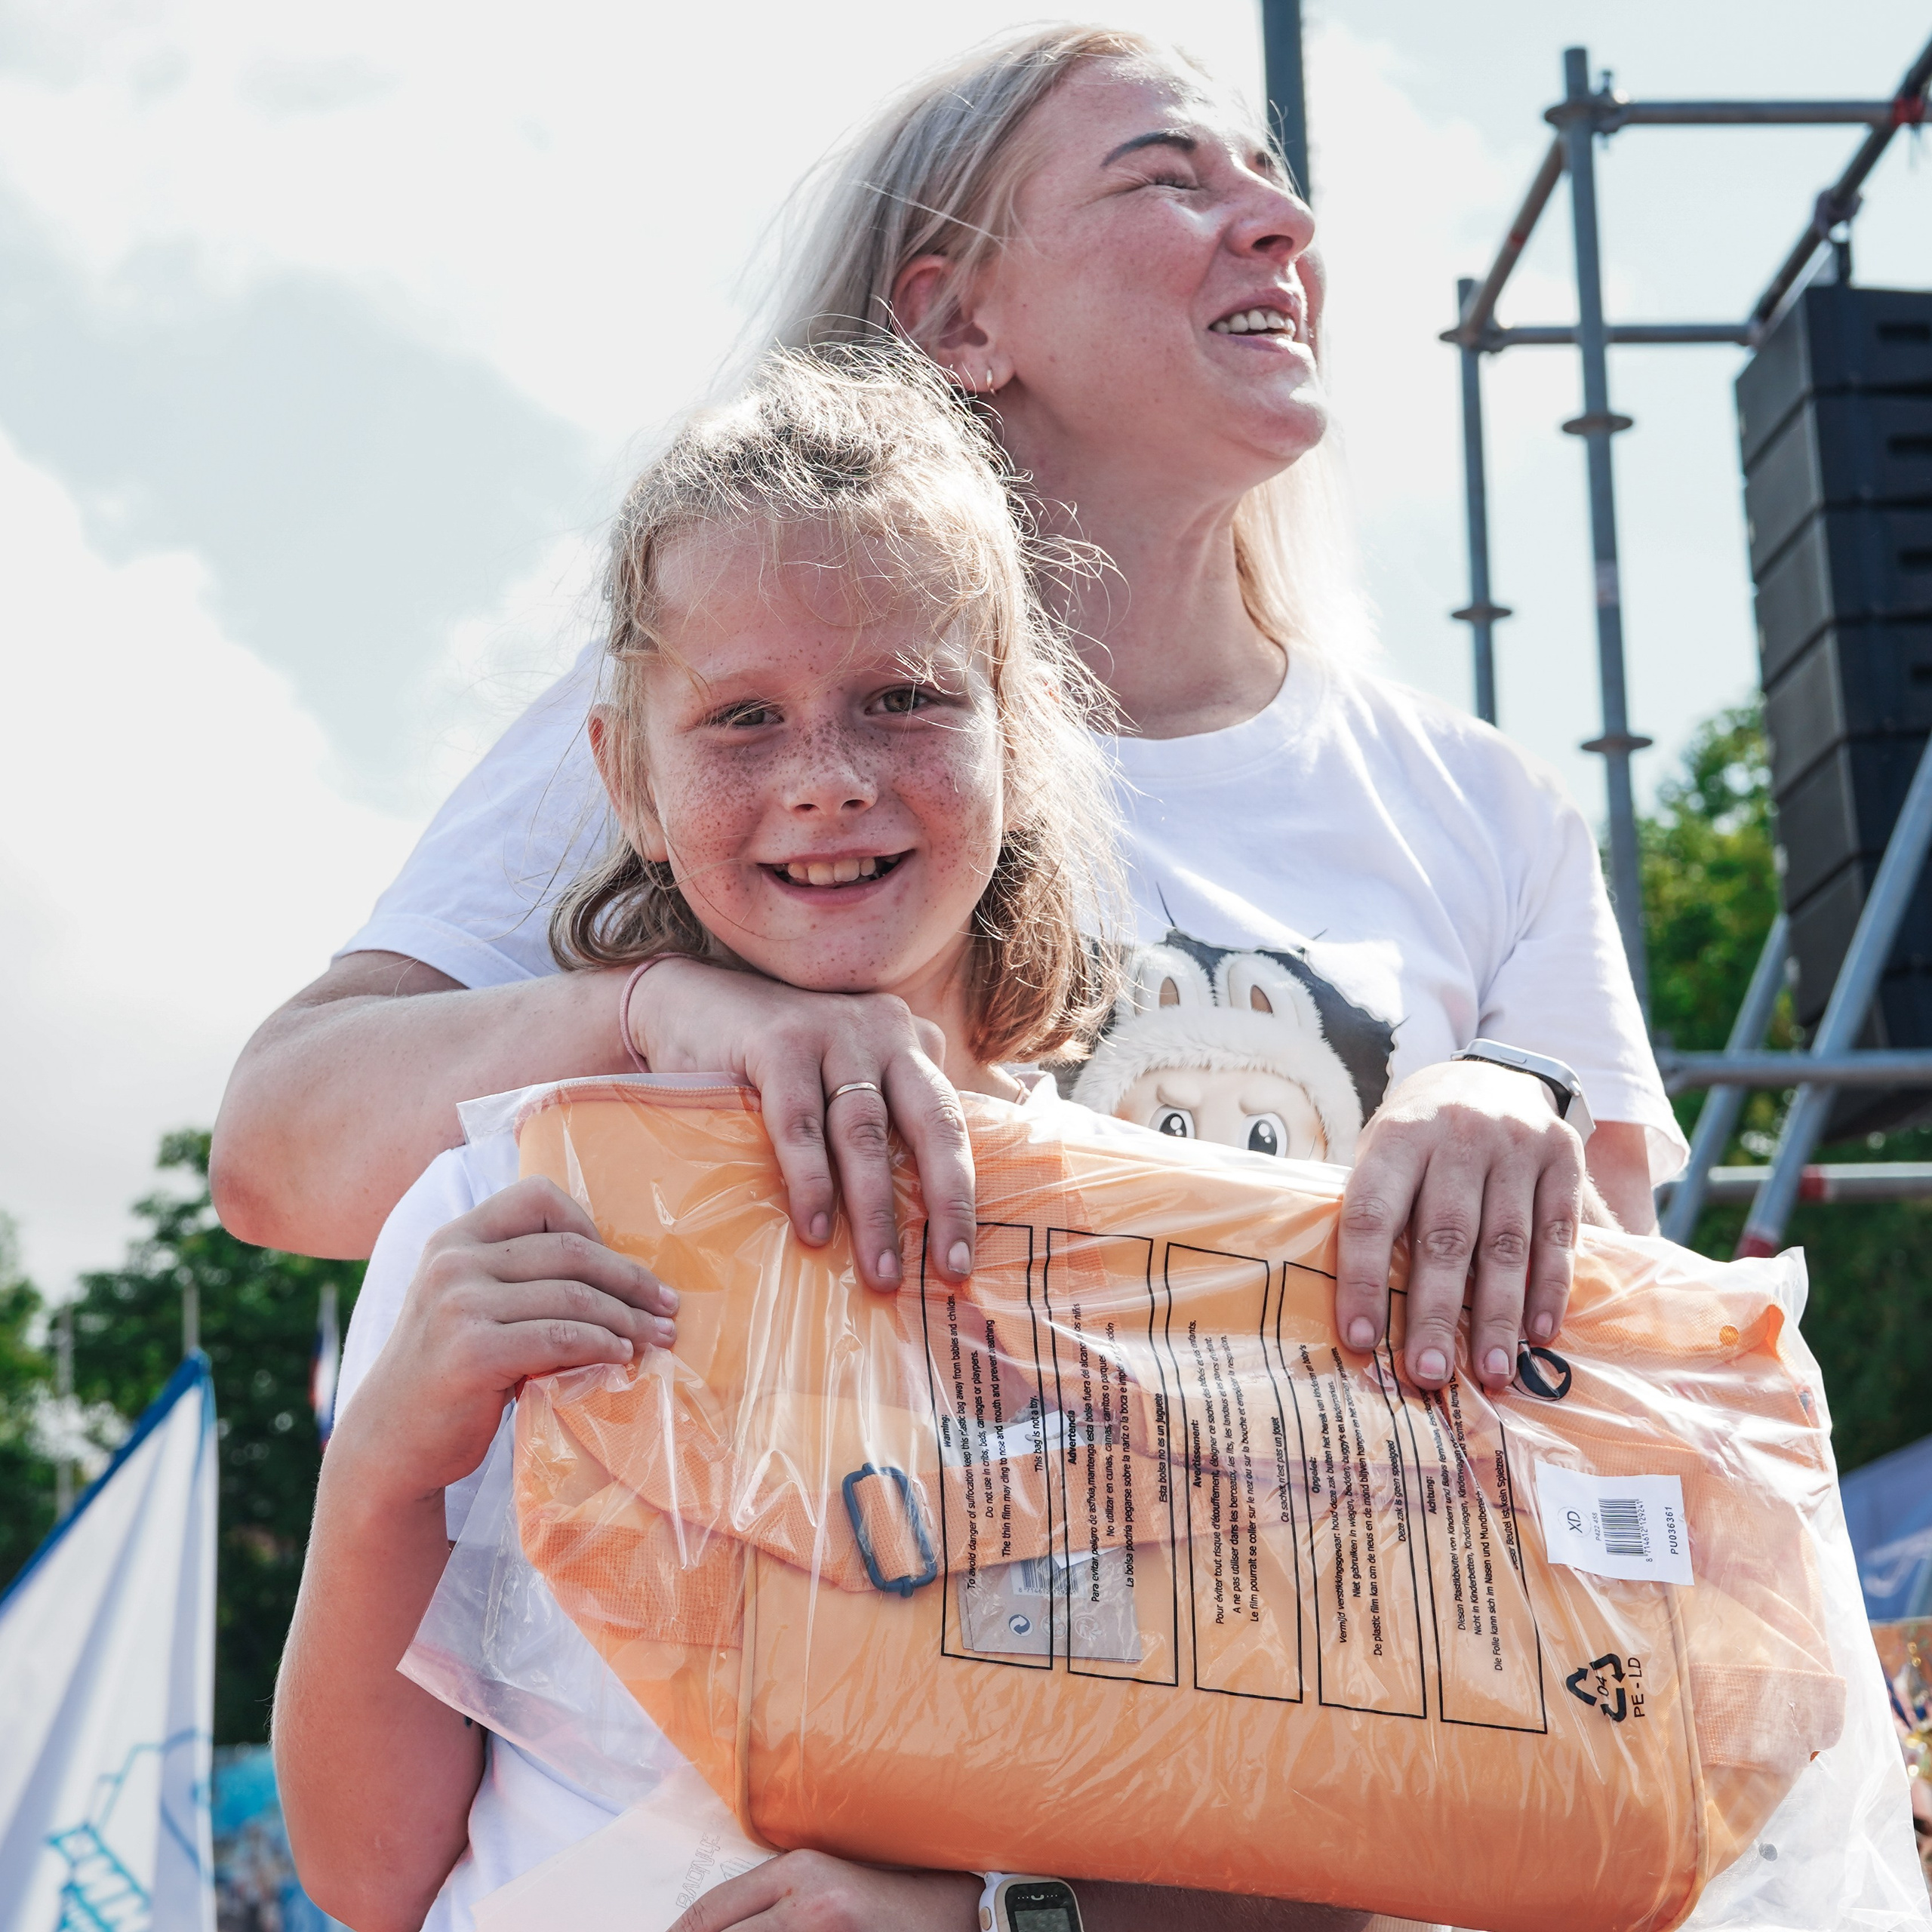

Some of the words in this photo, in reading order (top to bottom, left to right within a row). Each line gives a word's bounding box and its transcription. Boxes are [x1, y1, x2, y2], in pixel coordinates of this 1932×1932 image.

[948, 1323, 958, 1337] and
[950, 1337, 961, 1361] babies
[952, 1362, 961, 1380] from
[971, 1349, 983, 1384] playpens.
[988, 1355, 1001, 1382] prevent
[1080, 1368, 1090, 1379] del
[1098, 1354, 1110, 1383] parques
[1213, 1362, 1223, 1382] parcs
[955, 1380, 964, 1400] away
[989, 1383, 1000, 1398] and
[1082, 1380, 1091, 1401] fuera
[1449, 1383, 1460, 1408] Atmung
[955, 1400, 966, 1414] bag
[974, 1395, 985, 1429] carriages
[991, 1398, 1002, 1423] mouth
[1029, 1395, 1039, 1408] toy.
[1100, 1392, 1111, 1422] carritos
[1119, 1394, 1128, 1414] boca
[1154, 1393, 1165, 1425] juguete
[1204, 1399, 1215, 1423] sachet
[1221, 1398, 1231, 1426] landaus
[1316, 1399, 1325, 1411] van
[1030, 1416, 1040, 1429] not
[1083, 1403, 1094, 1423] bolsa
[1318, 1412, 1329, 1435] bereik
[1453, 1408, 1462, 1420] die
[940, 1414, 952, 1447] Warning:
[994, 1425, 1004, 1439] and
[1085, 1424, 1094, 1441] esta
[1224, 1427, 1232, 1439] les
[1238, 1417, 1249, 1444] bouche
[1270, 1416, 1282, 1436] jouet
[1454, 1420, 1465, 1441] somit
[960, 1437, 970, 1450] this
[977, 1430, 987, 1447] beds,
[1033, 1438, 1043, 1454] bag
[1066, 1410, 1077, 1465] Advertencia
[1104, 1423, 1112, 1452] camas,
[1121, 1432, 1130, 1453] nariz
[1226, 1441, 1235, 1454] lits,
[1321, 1435, 1331, 1448] het
[1355, 1429, 1365, 1456] hangen
[963, 1451, 972, 1467] keep
[980, 1448, 989, 1466] cribs,
[1190, 1419, 1201, 1487] Avertissement:
[1209, 1435, 1220, 1467] éloigner
[1275, 1447, 1284, 1463] pas
[1338, 1434, 1350, 1463] buggy's
[1386, 1438, 1399, 1476] speelgoed
[1034, 1456, 1043, 1472] This
[1105, 1454, 1114, 1481] cunas,
[1157, 1461, 1167, 1483] bolsa
[1226, 1456, 1235, 1467] les
[1324, 1450, 1334, 1474] buiten
[1358, 1457, 1369, 1482] blijven
[1494, 1449, 1507, 1487] Spielzeug
[984, 1477, 992, 1490] use
[1000, 1466, 1010, 1484] cling
[1121, 1463, 1131, 1487] sobre
[1276, 1463, 1285, 1483] n'est
[1309, 1457, 1321, 1494] Opgelet:
[1326, 1475, 1336, 1489] zak
[1343, 1466, 1352, 1497] bedden,
[1440, 1464, 1450, 1487] Babys
[1454, 1450, 1466, 1498] Kinderwagen
[964, 1469, 975, 1509] suffocation
[984, 1491, 993, 1504] not
[1003, 1484, 1011, 1502] may
[1158, 1485, 1168, 1503] Esta
[1228, 1469, 1238, 1508] berceaux,
[1278, 1484, 1288, 1510] sachet
[1392, 1478, 1403, 1498] geen
[1426, 1475, 1437, 1515] Achtung:
[1443, 1488, 1452, 1503] und
[1498, 1488, 1508, 1507] kein
[1105, 1495, 1115, 1523] utilizar
[1124, 1488, 1134, 1522] pegarse
[1210, 1469, 1220, 1530] d'étouffement,
[1329, 1489, 1337, 1509] deze
[985, 1506, 994, 1518] Do
[1001, 1504, 1011, 1520] film
[1229, 1510, 1238, 1522] les
[1329, 1510, 1340, 1531] houd
[1346, 1498, 1357, 1527] wiegen,
[1395, 1507, 1404, 1521] zak
[1445, 1505, 1455, 1535] Kindern
[1501, 1508, 1510, 1519] ist
[1567, 1511, 1583, 1534] XD
[1636, 1500, 1647, 1525] 129241
[968, 1520, 979, 1550] danger
[1001, 1522, 1011, 1539] thin
[1229, 1524, 1238, 1545] dans
[1247, 1520, 1257, 1543] coller
[1398, 1522, 1406, 1542] Deze
[1460, 1500, 1472, 1549] Kinderliegen,
[1502, 1521, 1514, 1546] Beutel
[1664, 1506, 1679, 1555] PU036361
[1090, 1527, 1100, 1555] peligro
[1123, 1524, 1135, 1551] podría
[1212, 1531, 1223, 1557] risque
[1366, 1532, 1374, 1552] neus
[1641, 1529, 1651, 1553] 714612
[1001, 1540, 1011, 1557] The
[1349, 1539, 1361, 1579] gebruiken
[1480, 1541, 1491, 1557] und
[968, 1552, 976, 1576] avoid
[1091, 1556, 1099, 1581] evitar
[1124, 1553, 1134, 1575] bolsa
[1214, 1558, 1222, 1577] tout
[1230, 1546, 1239, 1575] utiliser
[1484, 1558, 1493, 1584] Nasen
[1248, 1558, 1260, 1592] pourrait
[1369, 1565, 1377, 1579] om
[1449, 1552, 1463, 1602] Plastikbeutel
[1466, 1552, 1478, 1604] Kinderbetten,
[1091, 1583, 1100, 1602] Para
[1214, 1578, 1223, 1603] éviter
[1232, 1577, 1242, 1592] pas
[1352, 1581, 1361, 1598] Niet
[1369, 1581, 1378, 1596] kan
[1249, 1594, 1258, 1609] film
[1370, 1598, 1380, 1614] film
[1486, 1598, 1496, 1614] sich
[1215, 1604, 1224, 1624] Pour
[1457, 1604, 1466, 1631] Diesen
[1337, 1611, 1348, 1643] Vermijd
[1371, 1615, 1383, 1642] plastic
[1472, 1615, 1482, 1635] Nicht
[1490, 1615, 1498, 1635] kann
[1373, 1643, 1383, 1656] De
[1491, 1635, 1501, 1656] Folie
[1494, 1657, 1503, 1671] Die
[1595, 1675, 1609, 1697] 04
